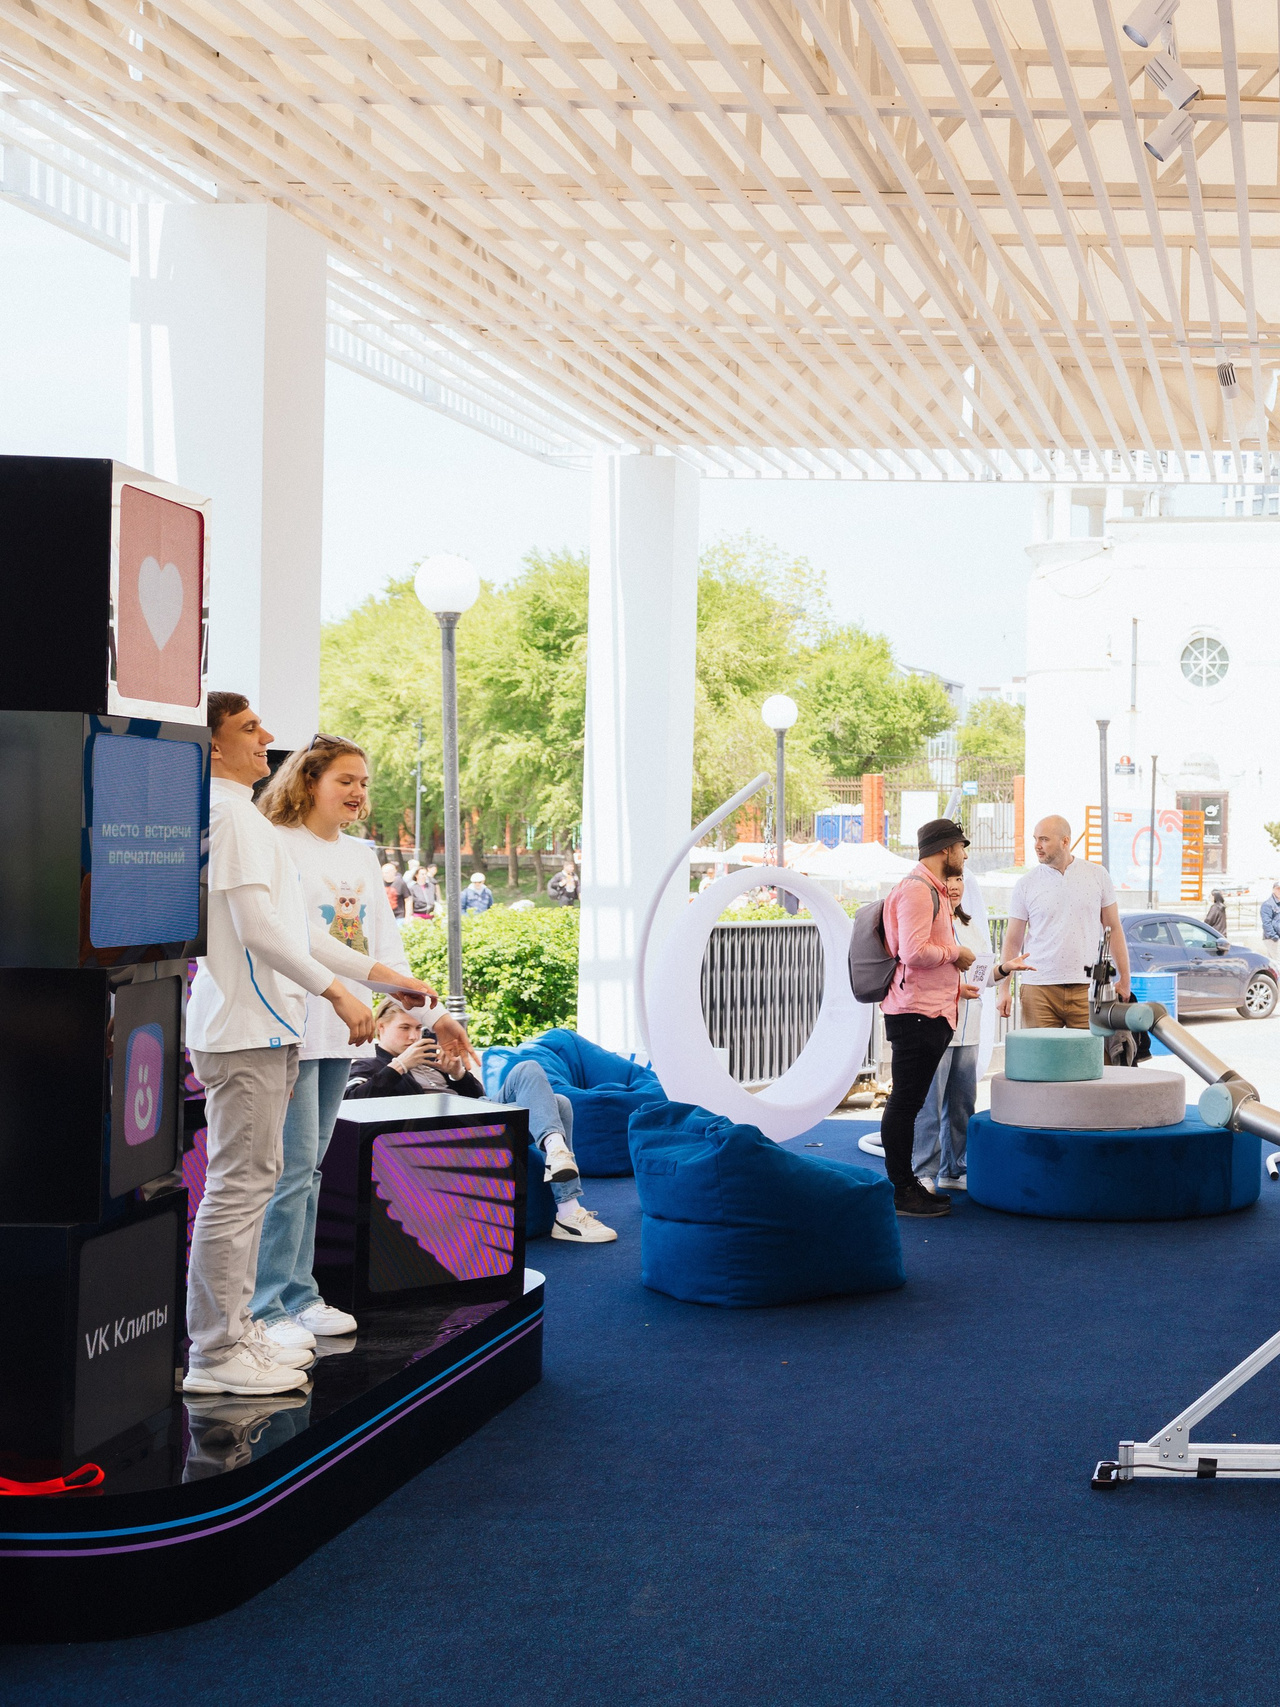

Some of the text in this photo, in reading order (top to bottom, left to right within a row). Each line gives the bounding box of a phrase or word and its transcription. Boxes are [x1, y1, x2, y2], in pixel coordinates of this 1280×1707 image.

[102, 823, 191, 842] место встречи
[108, 847, 185, 864] впечатлений
[85, 1304, 168, 1360] VK Клипы
